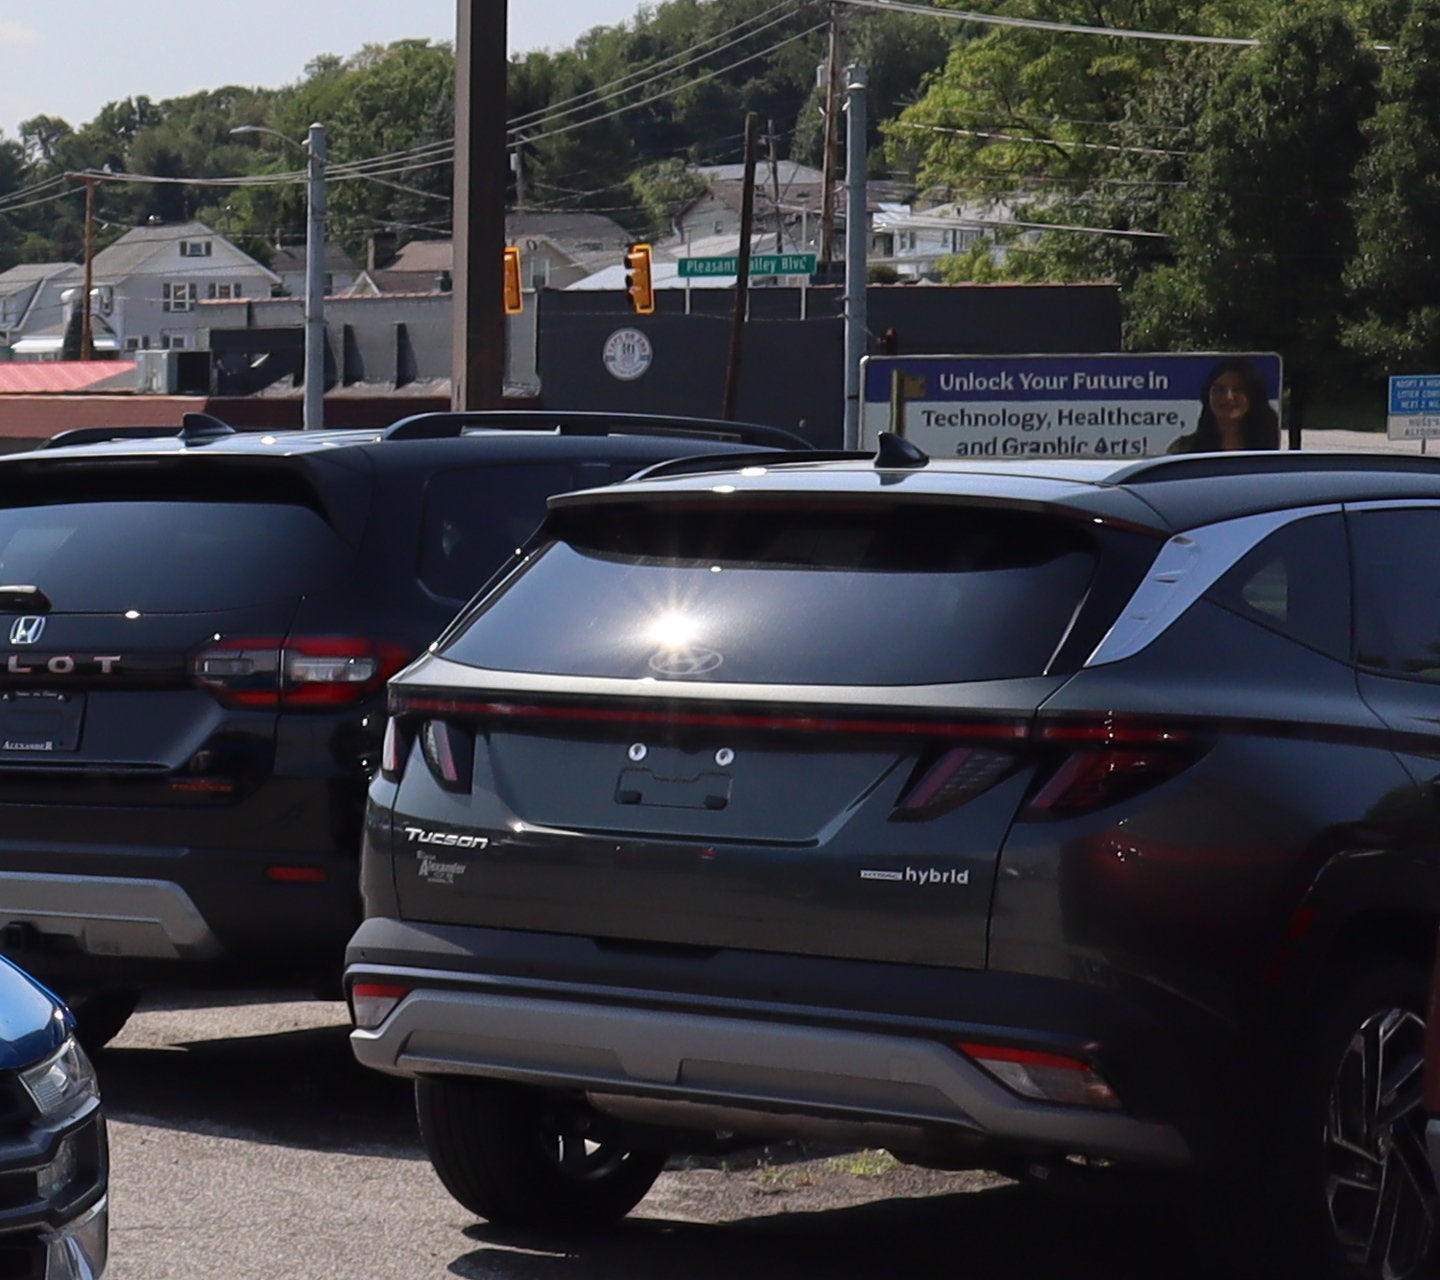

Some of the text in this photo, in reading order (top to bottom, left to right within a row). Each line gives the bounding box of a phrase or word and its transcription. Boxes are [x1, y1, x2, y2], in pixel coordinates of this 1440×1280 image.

[686, 259, 736, 273] Pleasant
[749, 258, 777, 274] alley
[939, 372, 1014, 391] Unlock
[1018, 372, 1068, 391] Your
[1072, 372, 1145, 390] Future
[921, 407, 1186, 431] Technology, Healthcare,
[956, 437, 997, 456] and
[1093, 436, 1148, 456] Arts!
[905, 866, 970, 886] hybrid
